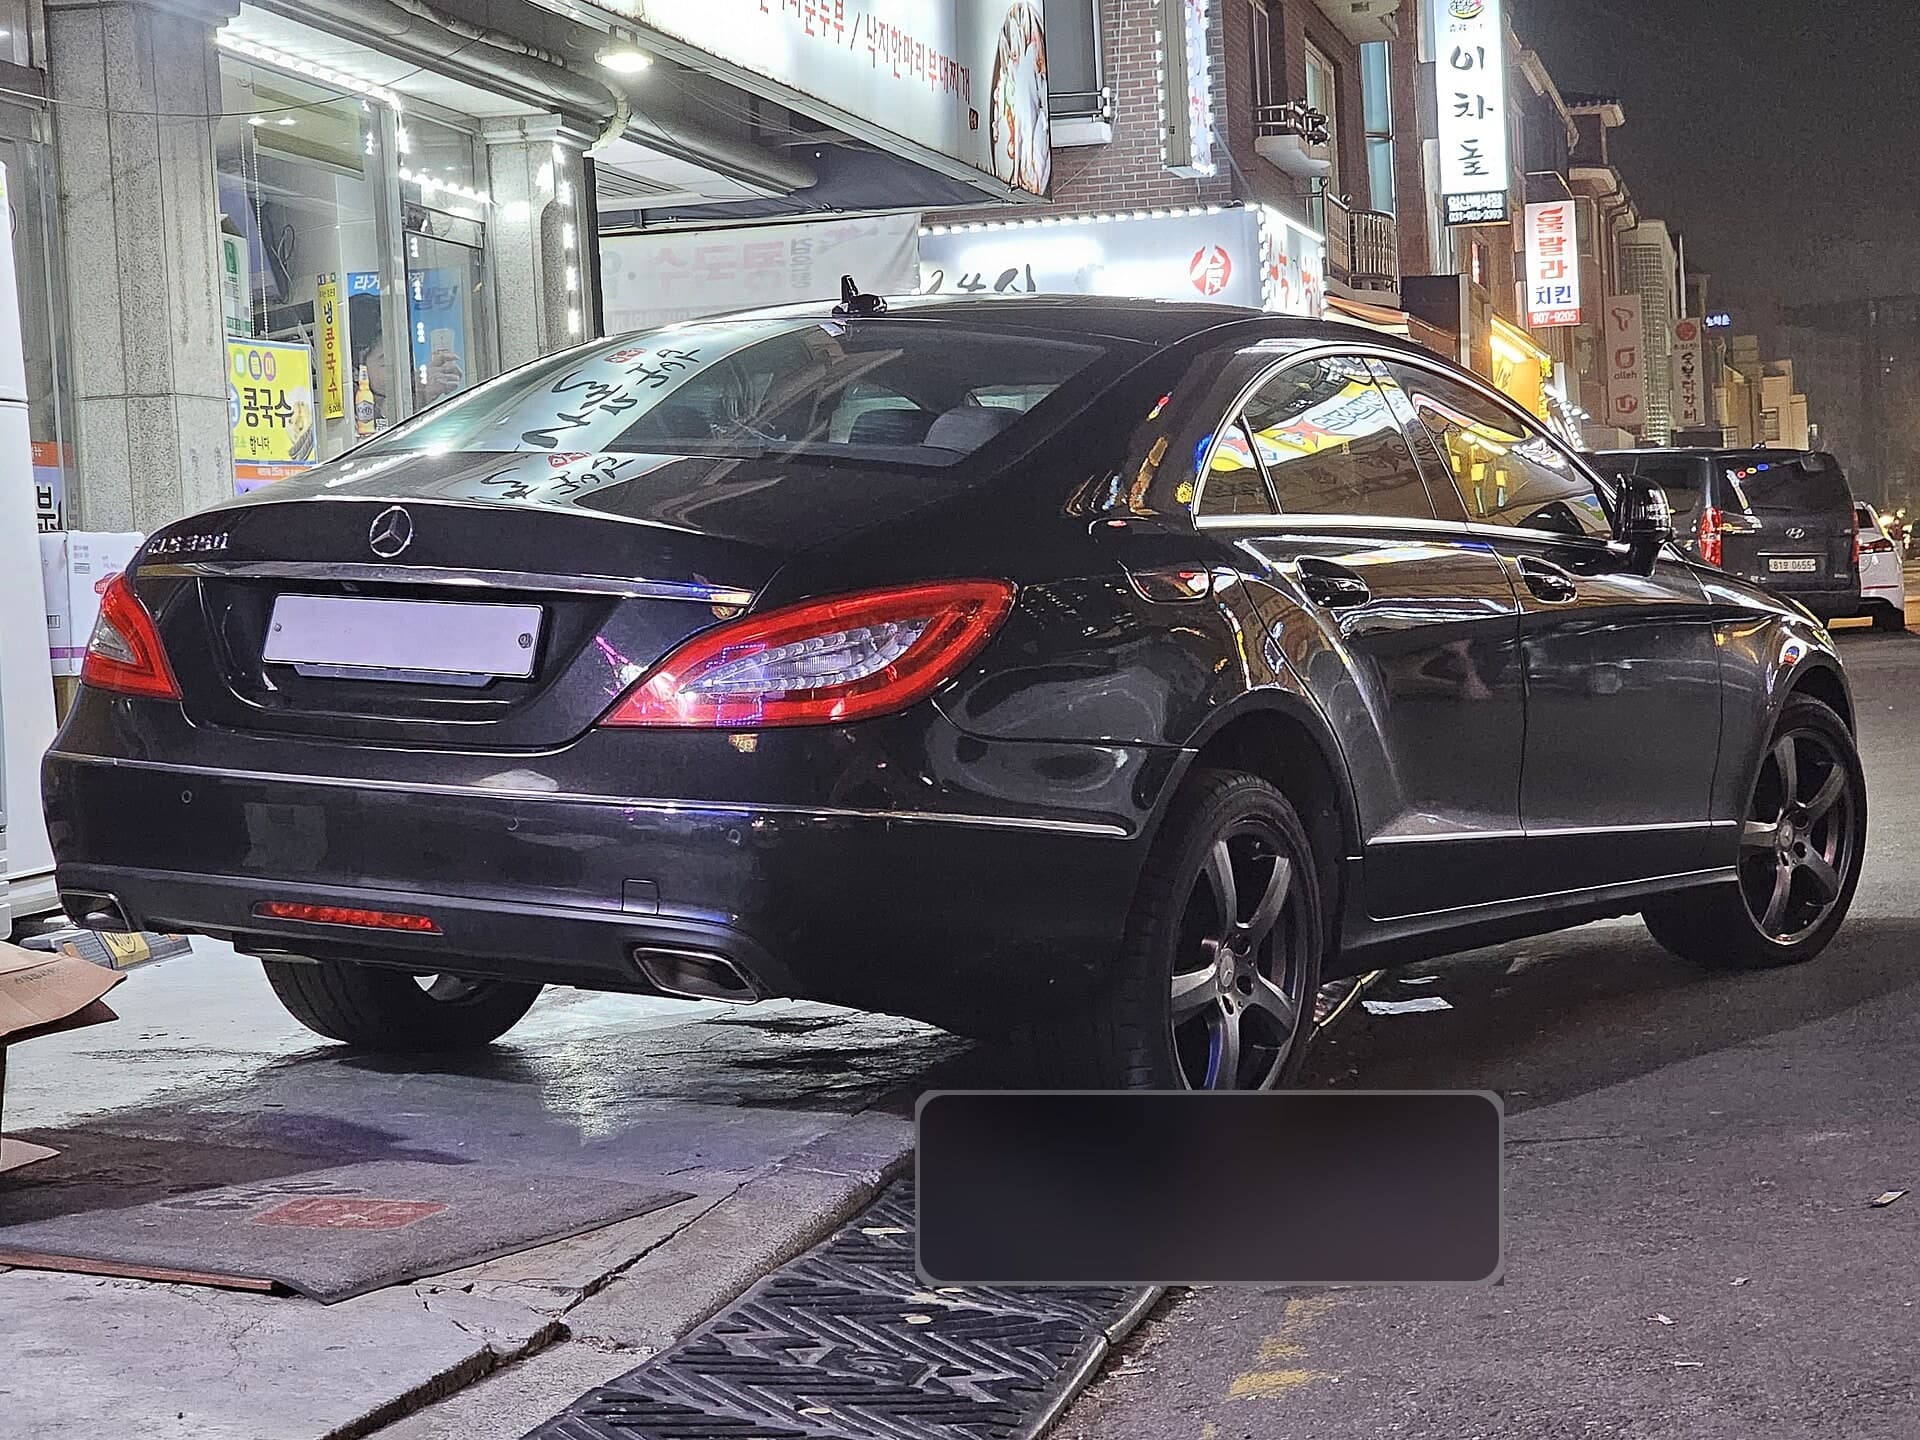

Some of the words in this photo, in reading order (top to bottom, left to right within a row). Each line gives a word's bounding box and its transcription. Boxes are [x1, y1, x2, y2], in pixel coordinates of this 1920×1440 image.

[1535, 285, 1572, 305] 치킨
[322, 301, 339, 399] 냉콩국수
[1613, 371, 1638, 380] olleh
[243, 387, 295, 428] 콩국수
